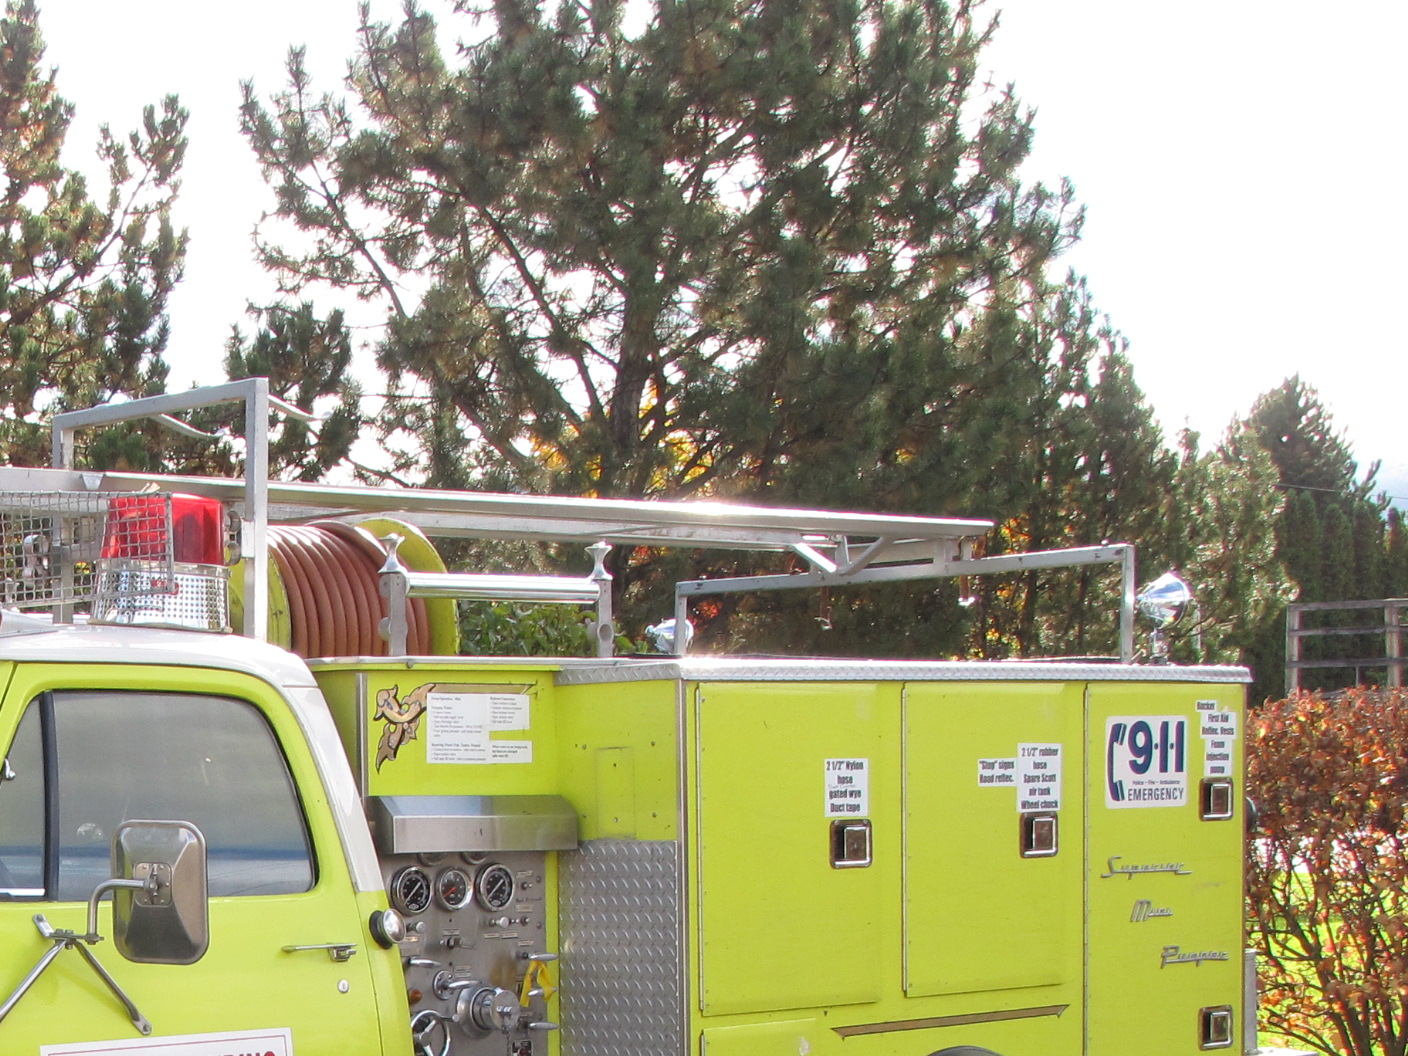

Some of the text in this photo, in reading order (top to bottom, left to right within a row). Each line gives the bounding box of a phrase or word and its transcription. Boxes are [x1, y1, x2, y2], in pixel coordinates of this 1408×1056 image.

[1039, 747, 1059, 757] rubber
[826, 760, 831, 771] 2
[845, 760, 864, 771] Nylon
[1033, 761, 1047, 770] hose
[837, 774, 853, 785] hose
[829, 789, 847, 800] gated
[1127, 787, 1184, 801] EMERGENCY
[830, 803, 861, 813] Duct tape
[1021, 800, 1040, 810] Wheel
